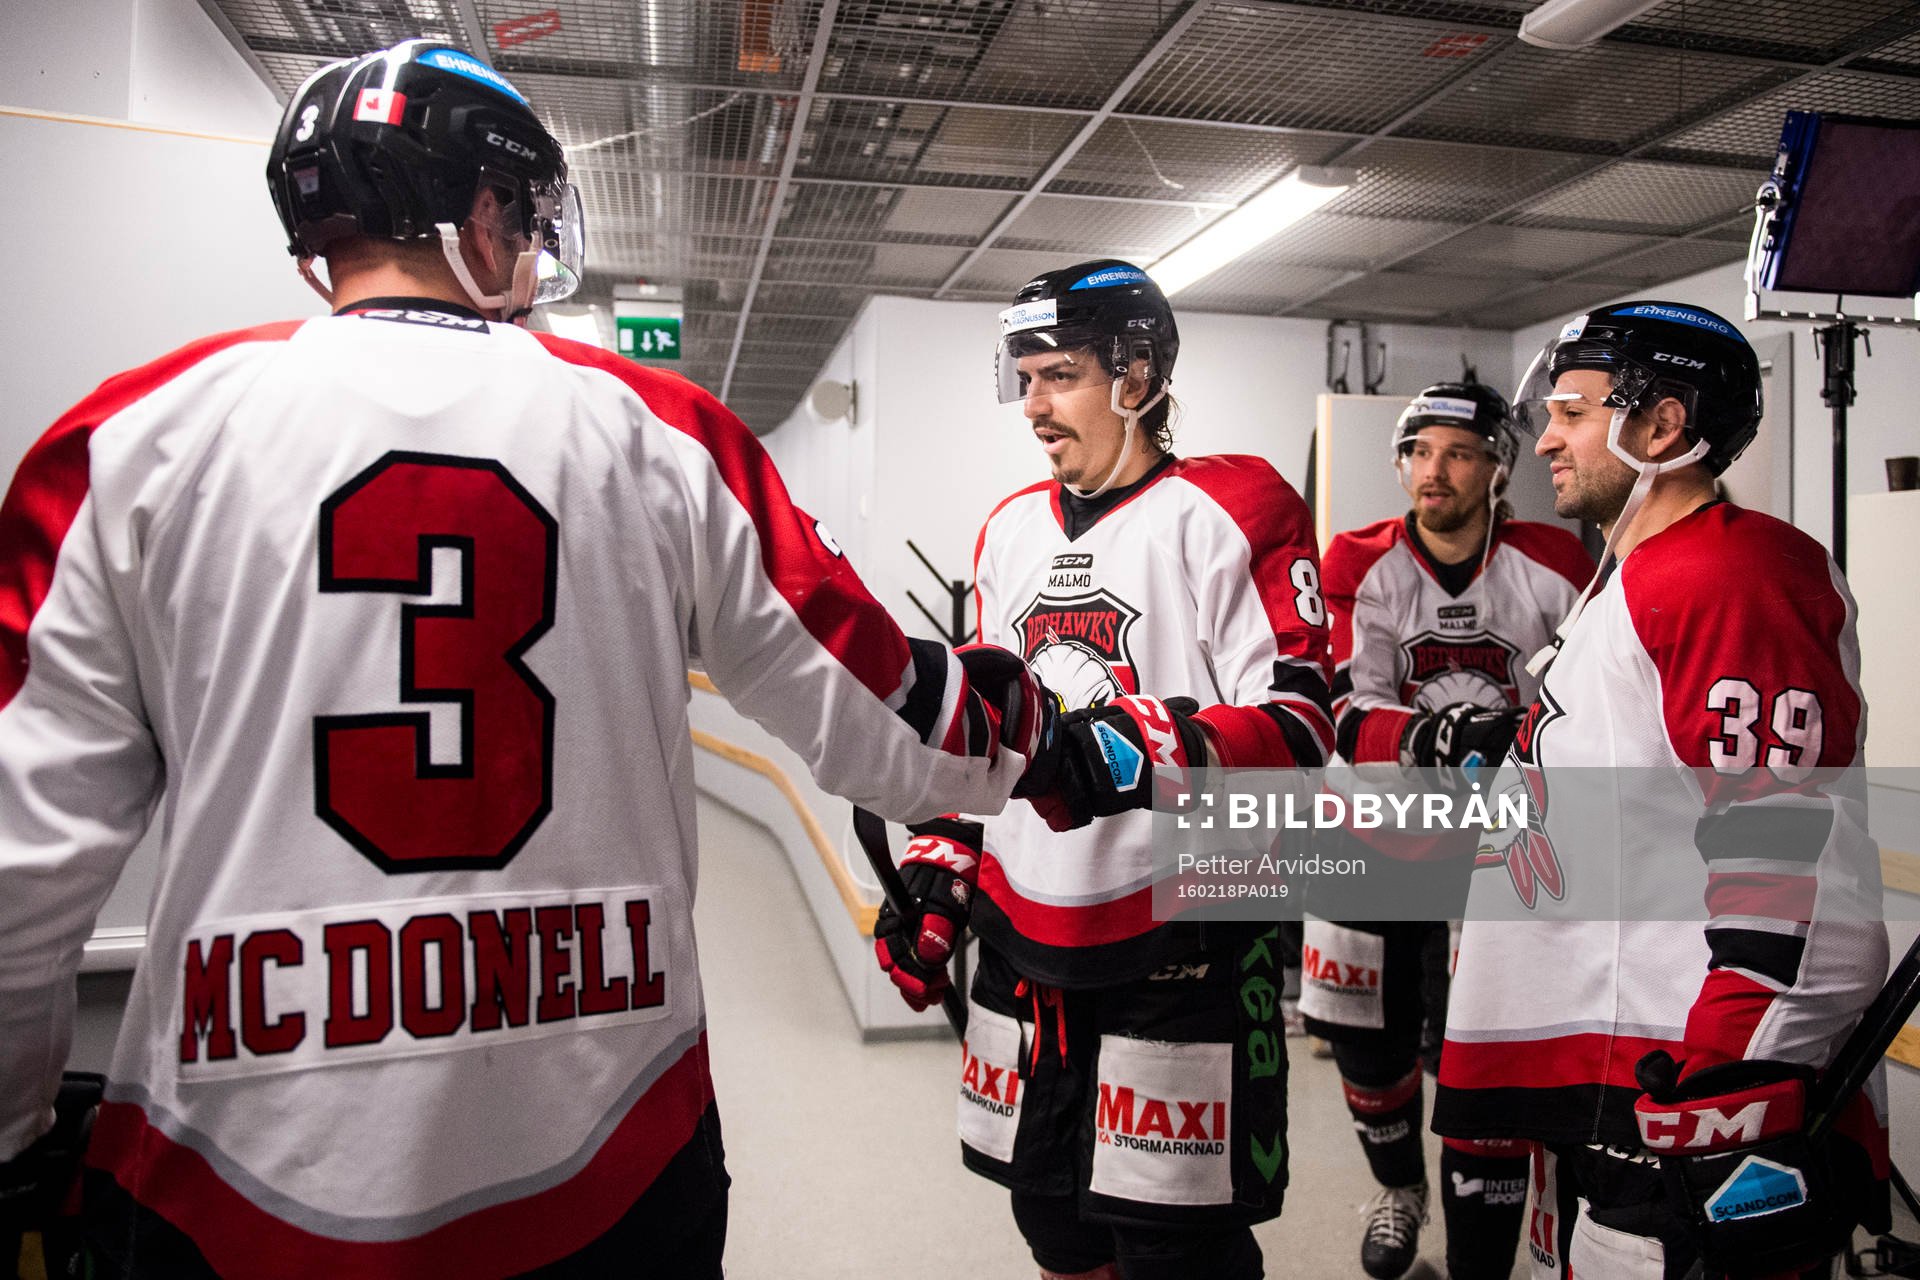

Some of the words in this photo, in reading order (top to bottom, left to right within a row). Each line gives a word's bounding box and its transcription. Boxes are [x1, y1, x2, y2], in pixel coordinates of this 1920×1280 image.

[294, 104, 320, 142] 3
[486, 131, 537, 161] CCM
[1633, 305, 1729, 334] EHRENBORG
[1653, 352, 1707, 370] CCM
[1048, 573, 1091, 588] MALMÖ
[1052, 556, 1092, 566] CCM
[1288, 557, 1326, 628] 8
[1025, 610, 1118, 661] REDHAWKS
[314, 449, 559, 876] 3
[1126, 694, 1184, 785] CM
[1706, 675, 1824, 784] 39
[1098, 726, 1124, 785] SCANDCON
[903, 838, 976, 873] CM
[323, 900, 666, 1049] DONELL
[1148, 963, 1211, 981] CM
[1303, 944, 1378, 987] MAXI
[1097, 1082, 1226, 1141] MAXI
[1634, 1100, 1771, 1150] CM
[1114, 1133, 1225, 1156] STORMARKNAD
[1714, 1191, 1800, 1217] SCANDCON
